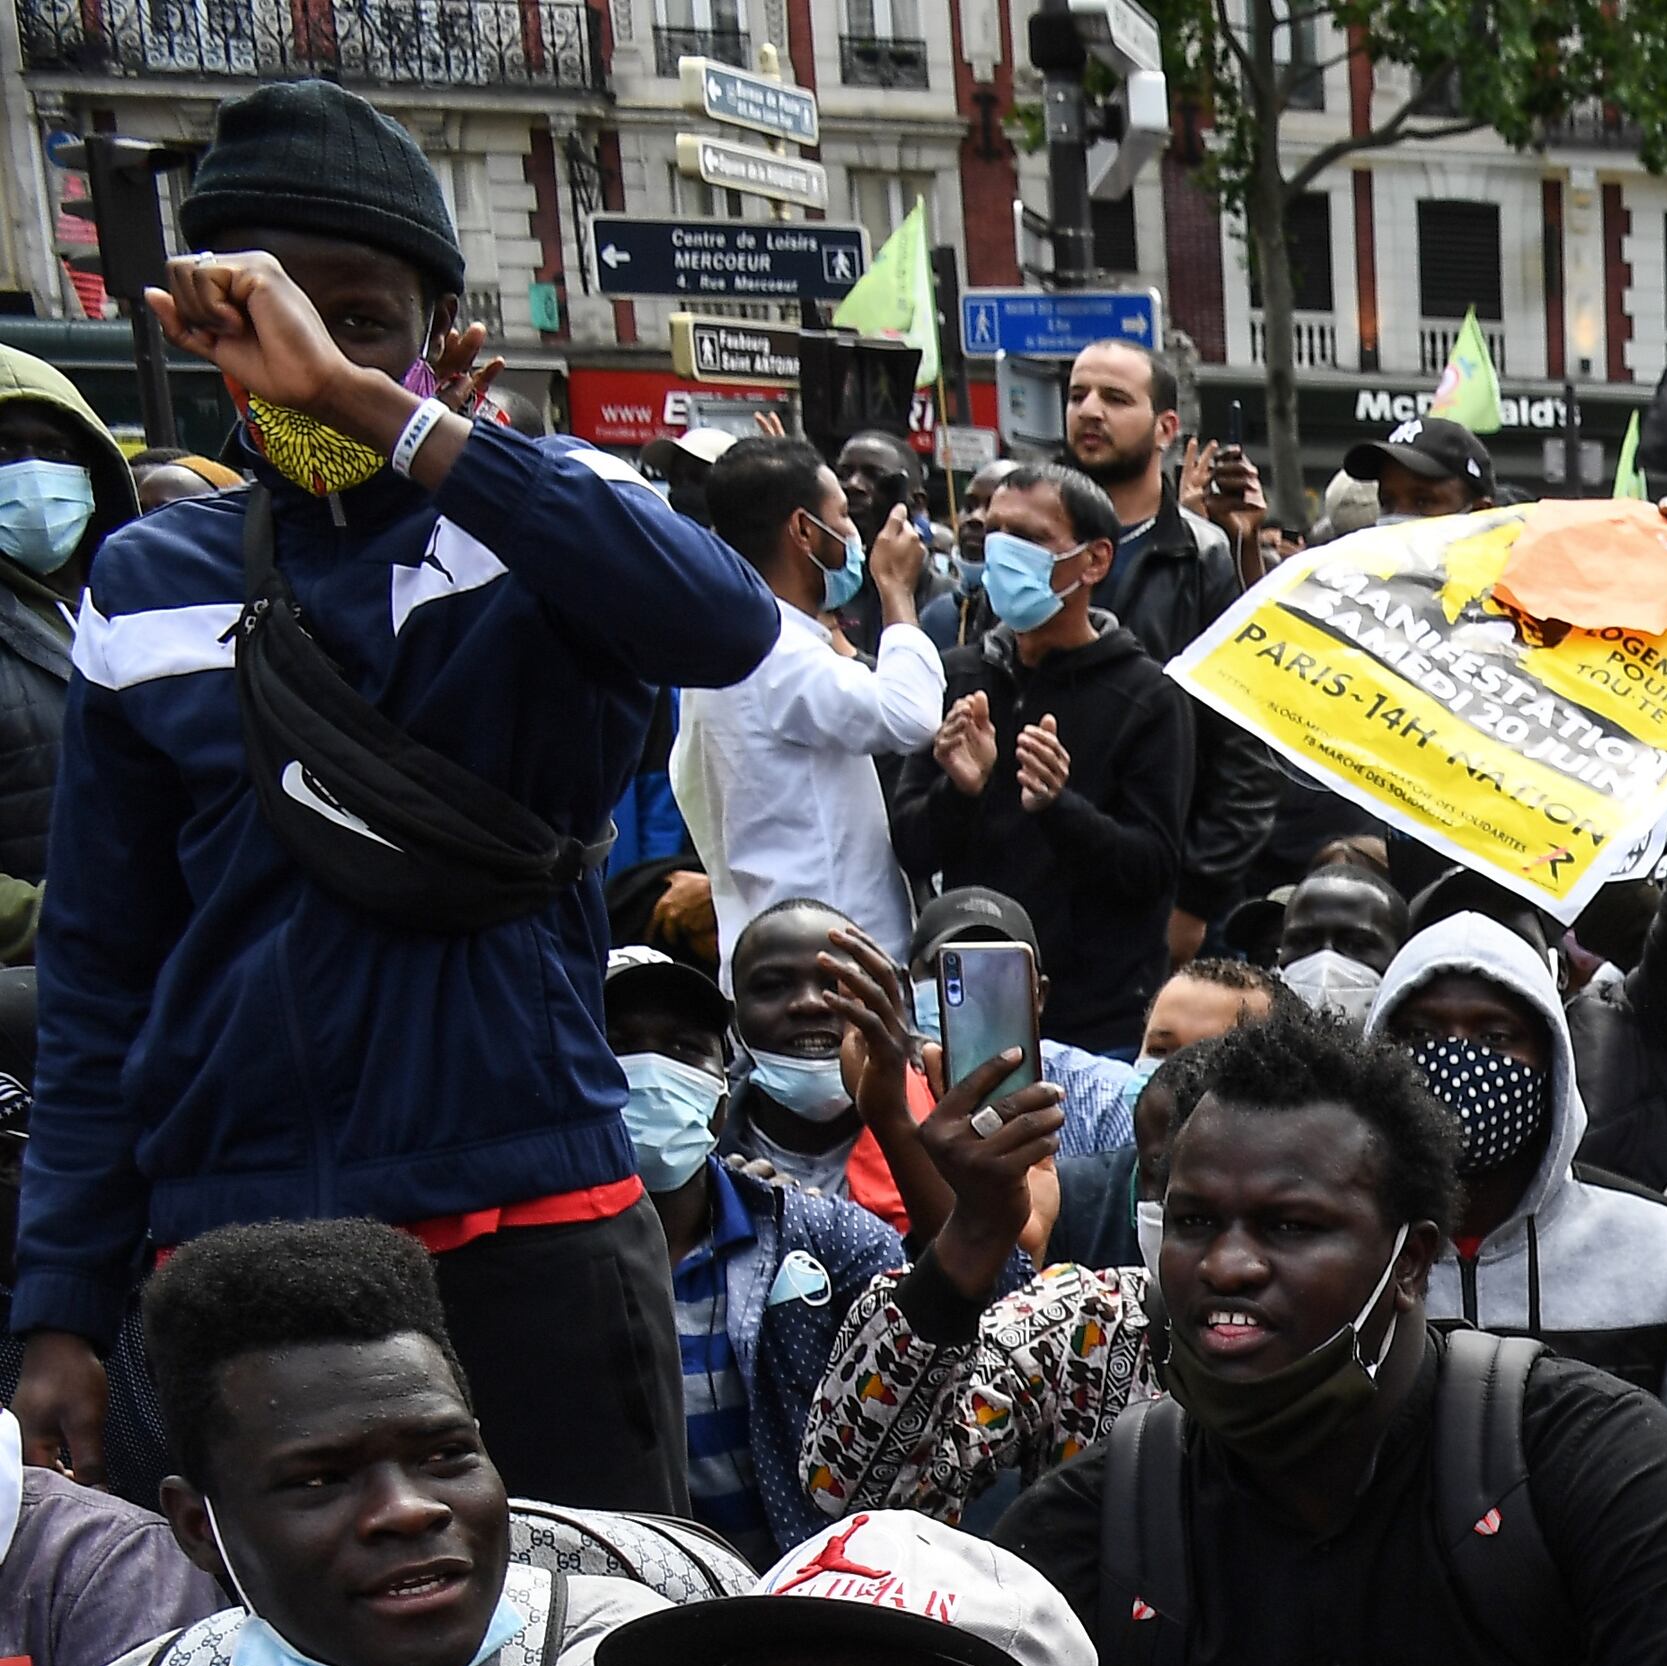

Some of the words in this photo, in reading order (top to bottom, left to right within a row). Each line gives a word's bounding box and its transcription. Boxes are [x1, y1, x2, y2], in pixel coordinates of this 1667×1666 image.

[672, 229, 726, 248] Centre
[736, 231, 756, 250] de
[766, 232, 818, 252] Loisirs
[674, 251, 771, 272] MERCOEUR
[700, 275, 726, 291] Rue
[601, 404, 653, 424] www
[1356, 389, 1581, 429] McDald's
[1308, 594, 1473, 712] SAMEDI
[1469, 702, 1531, 746] 20
[1522, 738, 1630, 802] JUIN
